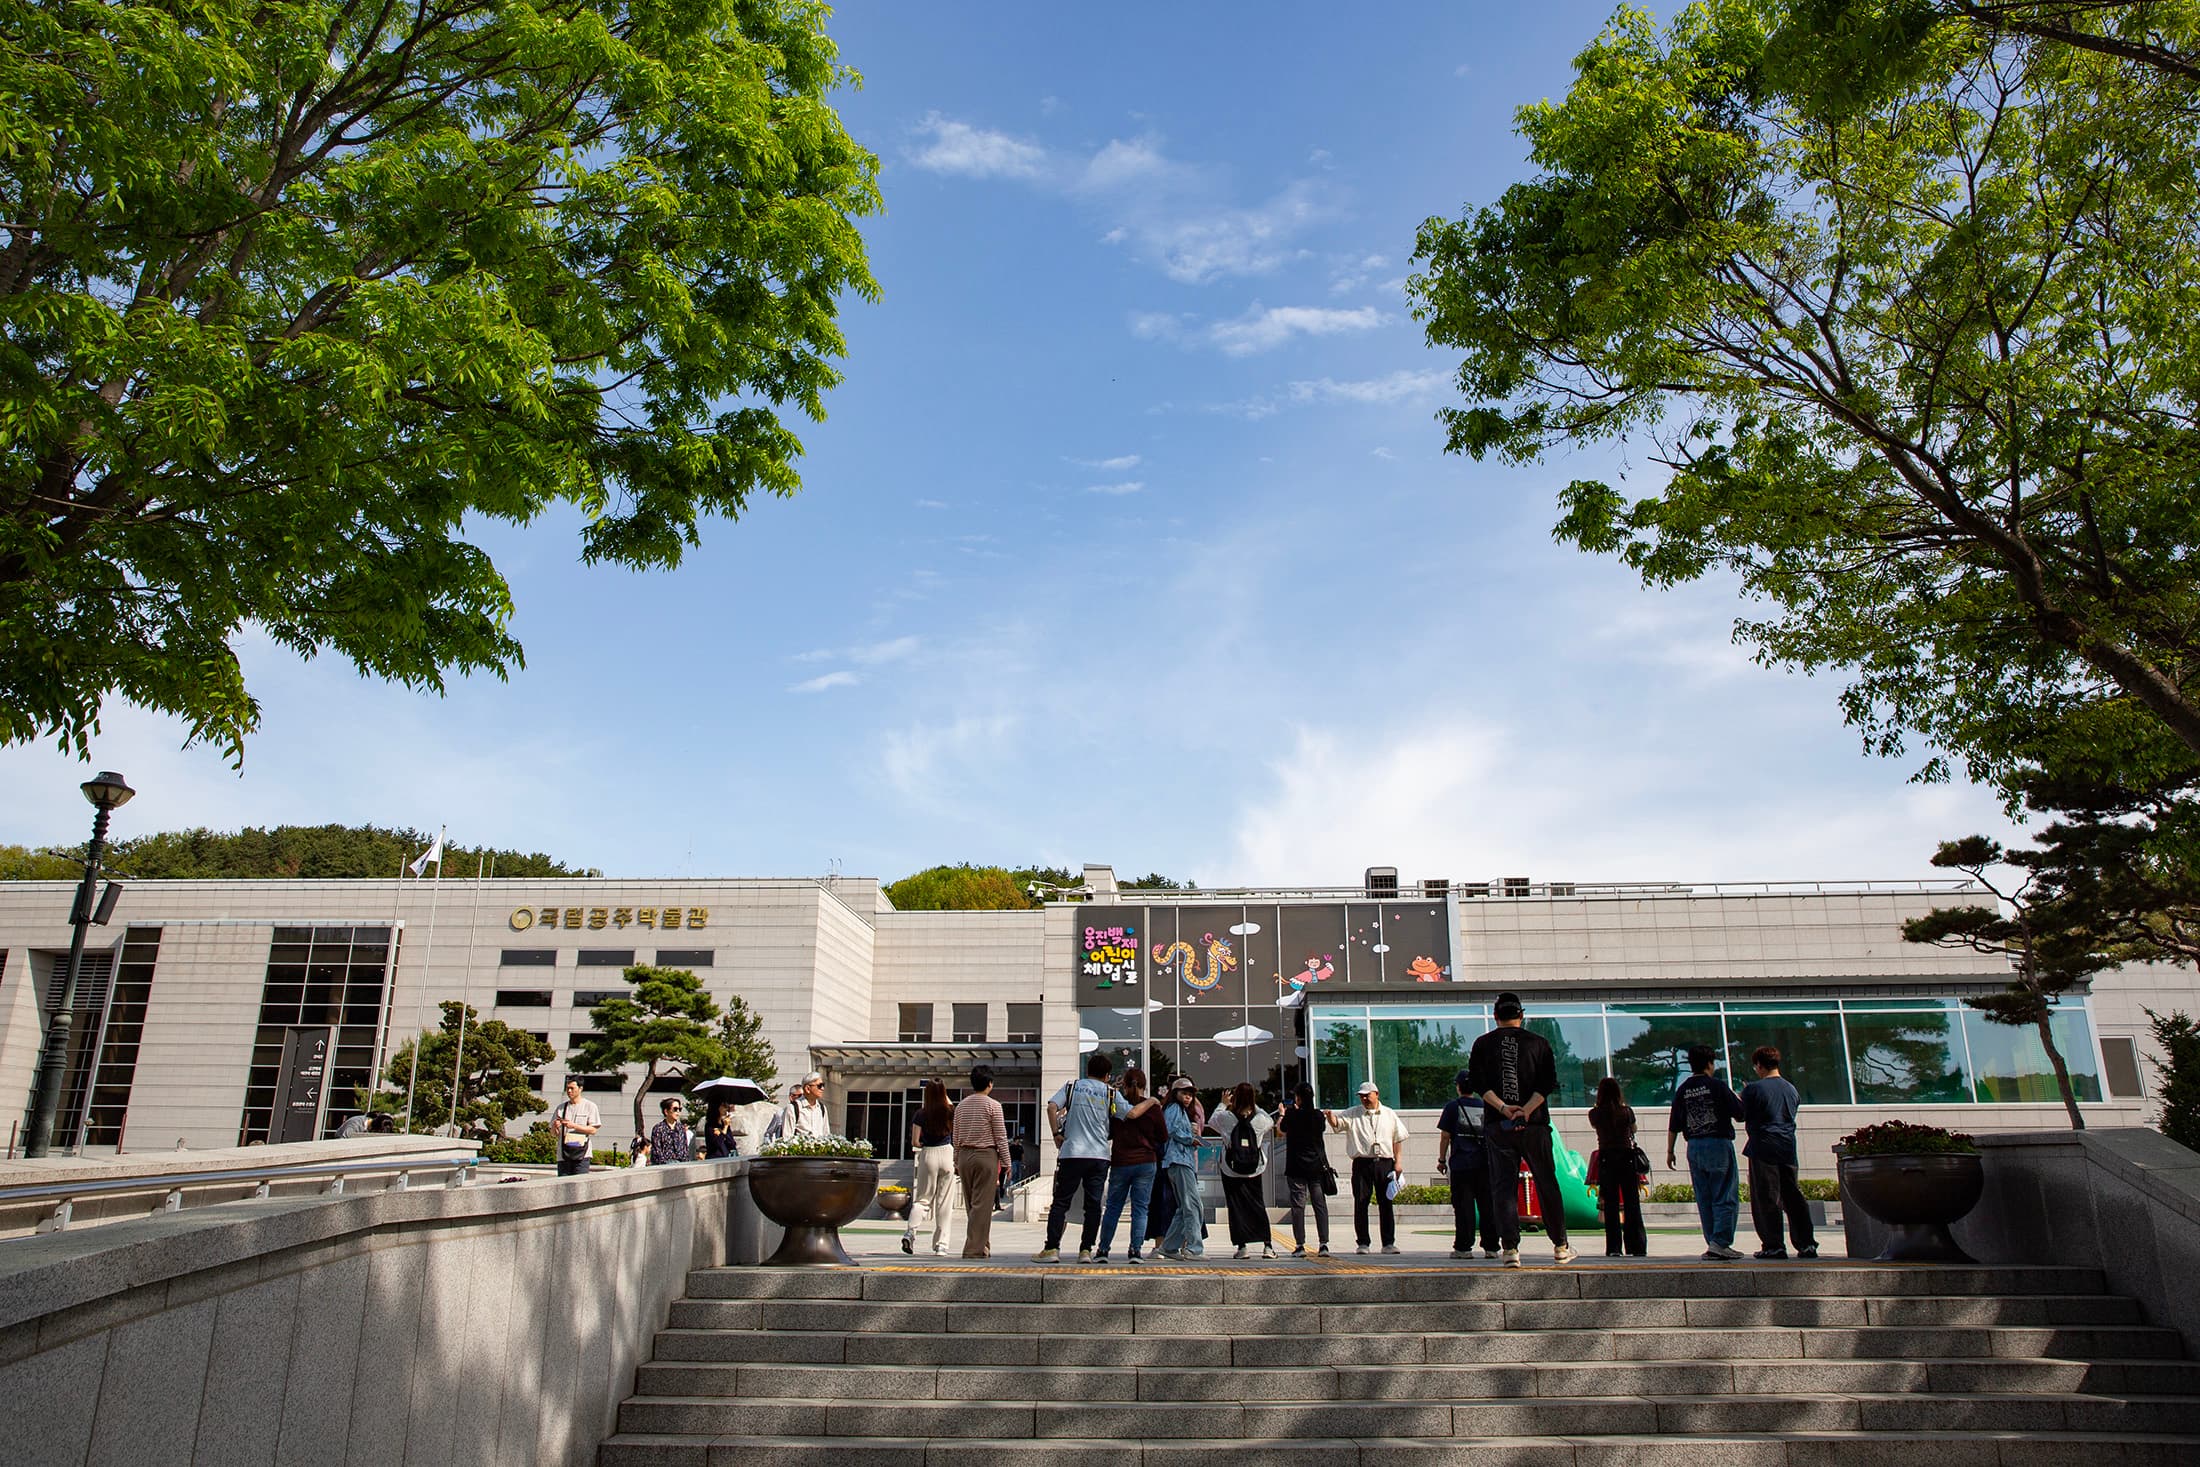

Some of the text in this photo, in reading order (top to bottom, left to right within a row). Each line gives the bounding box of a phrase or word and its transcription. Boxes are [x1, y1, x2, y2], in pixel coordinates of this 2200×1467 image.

[540, 907, 709, 929] 국립공주박물관
[1084, 926, 1138, 950] 웅진백제
[1090, 946, 1135, 963] 어린이
[1083, 960, 1138, 984] 체험실
